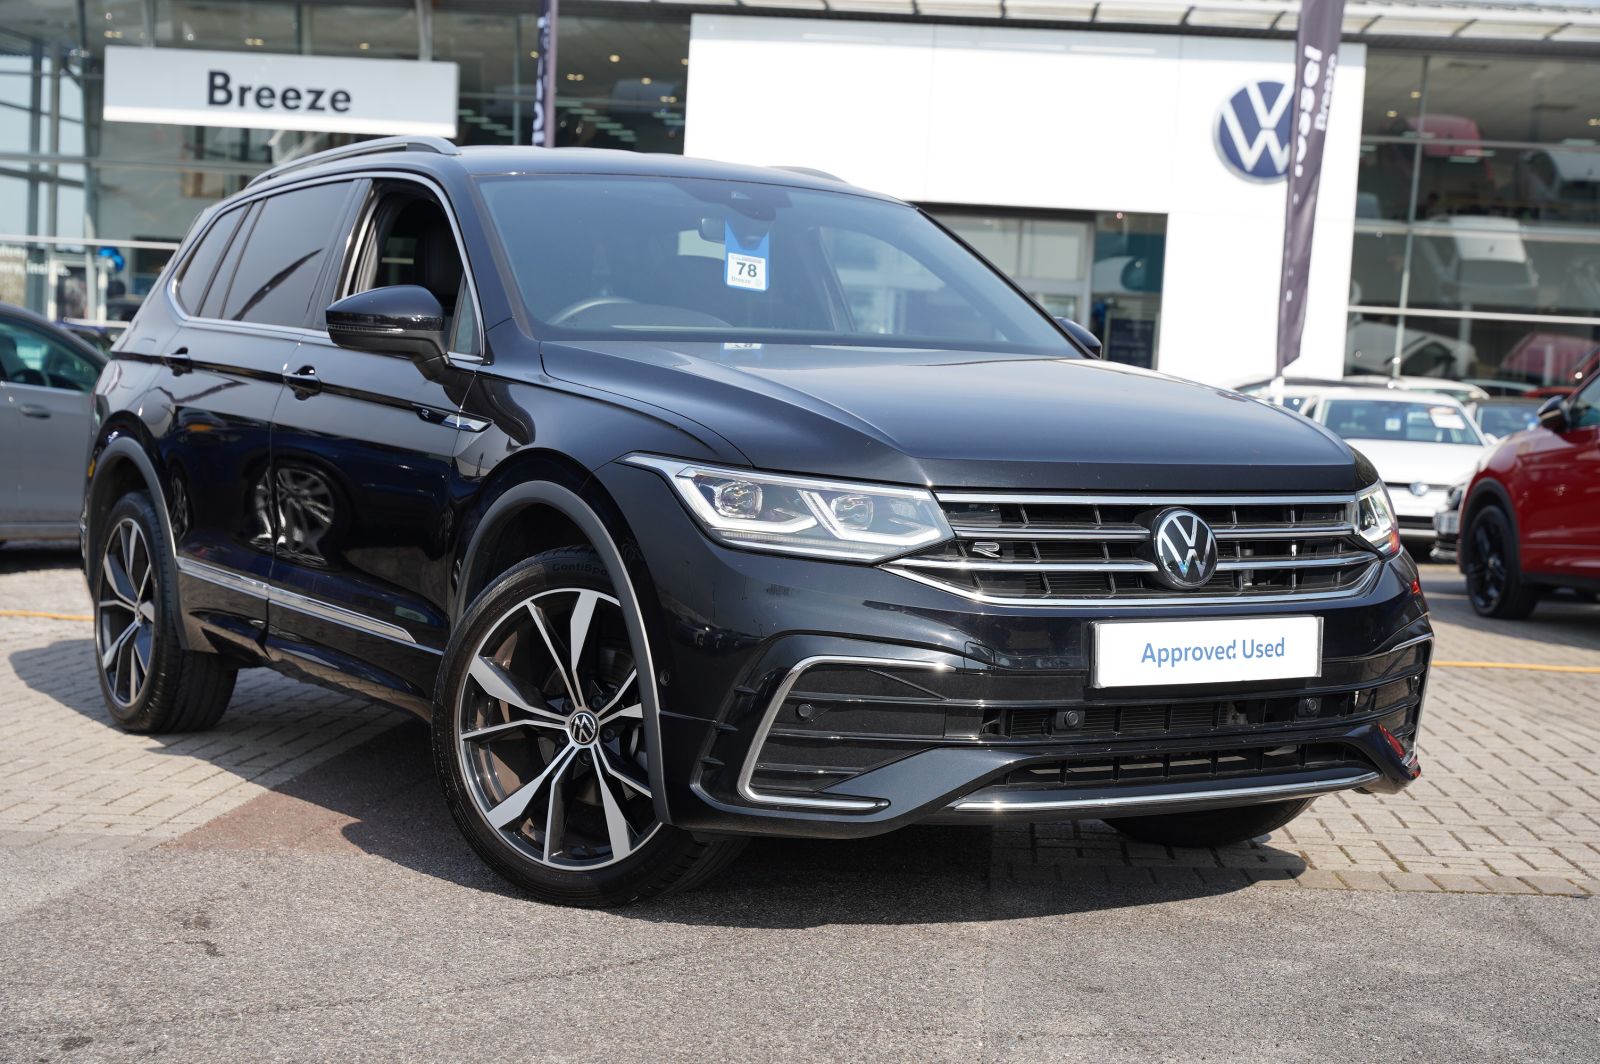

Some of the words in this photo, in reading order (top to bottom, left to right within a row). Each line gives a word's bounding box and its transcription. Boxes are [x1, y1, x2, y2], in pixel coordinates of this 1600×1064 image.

[207, 70, 352, 113] Breeze
[736, 261, 757, 278] 78
[551, 562, 609, 577] ContiSpo
[1141, 639, 1237, 668] Approved
[1242, 637, 1285, 659] Used
